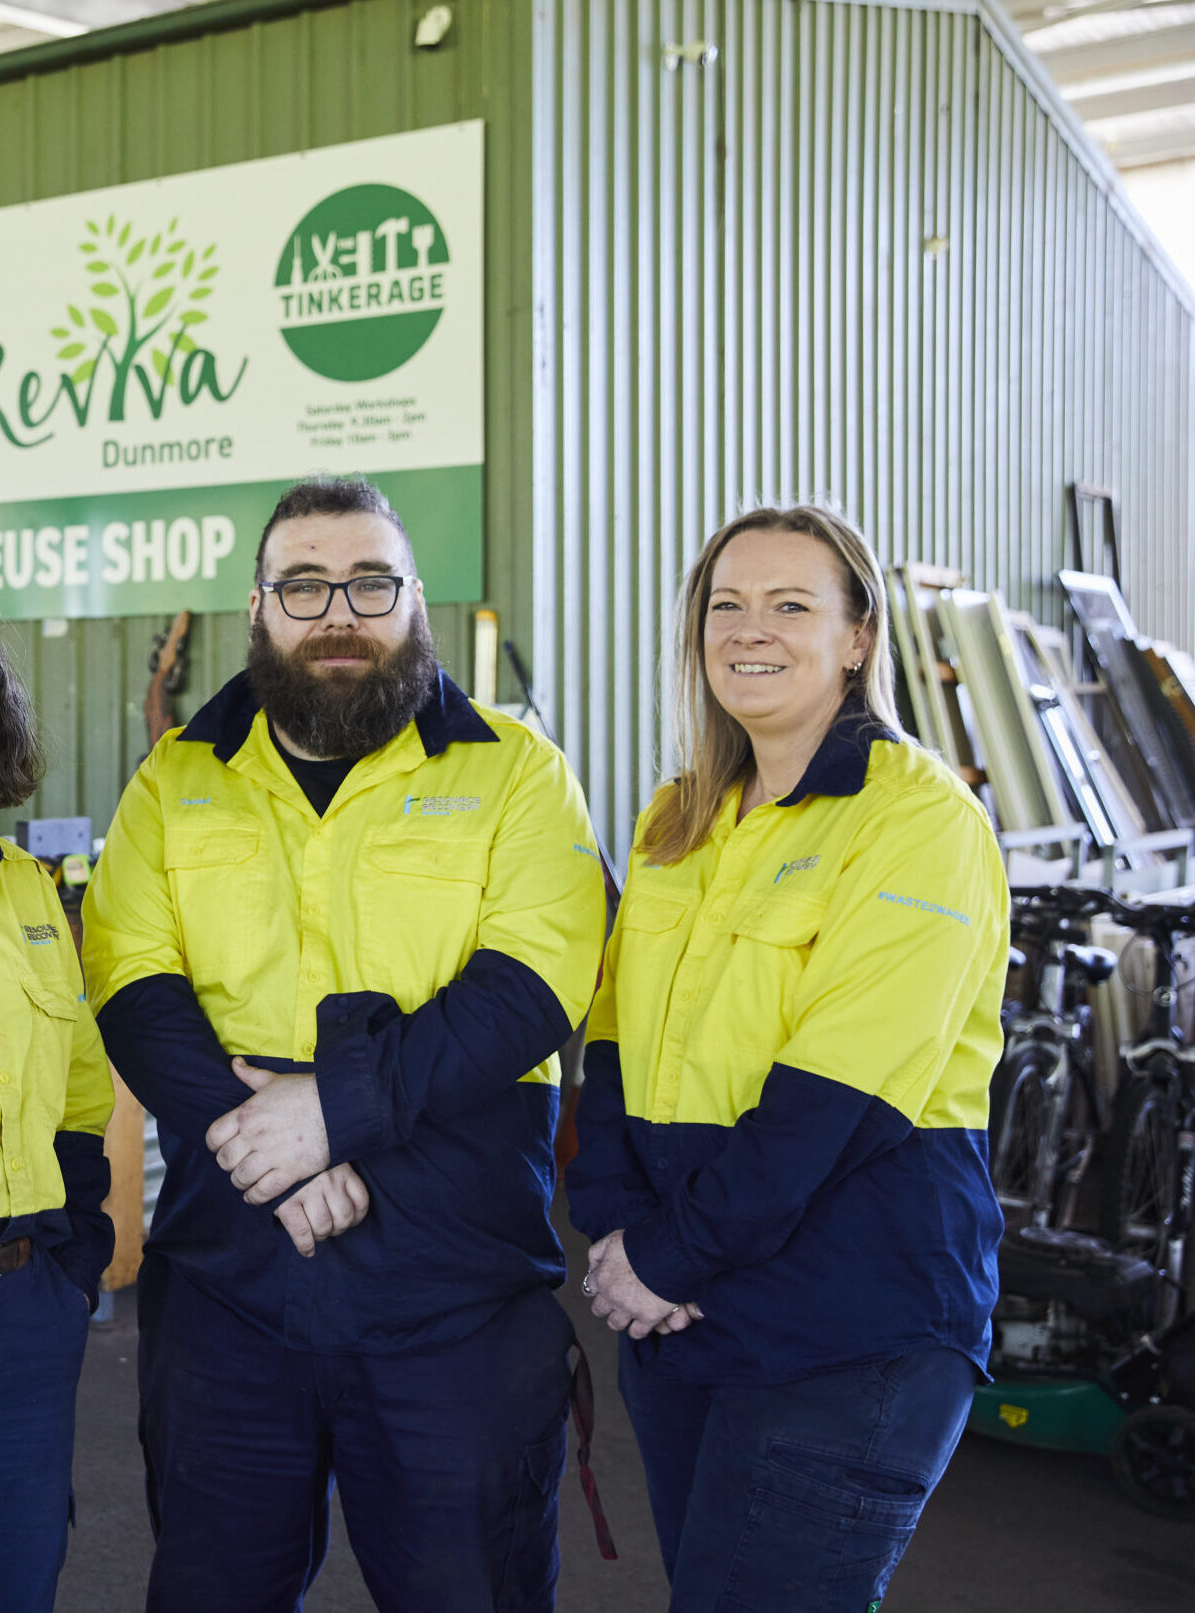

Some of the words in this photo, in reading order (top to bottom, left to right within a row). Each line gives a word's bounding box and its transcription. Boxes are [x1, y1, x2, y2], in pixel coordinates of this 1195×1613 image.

[281, 273, 443, 319] TINKERAGE
[102, 436, 234, 469] Dunmore
[101, 514, 236, 584] SHOP
[878, 891, 970, 927] #WASTE2WAGES
